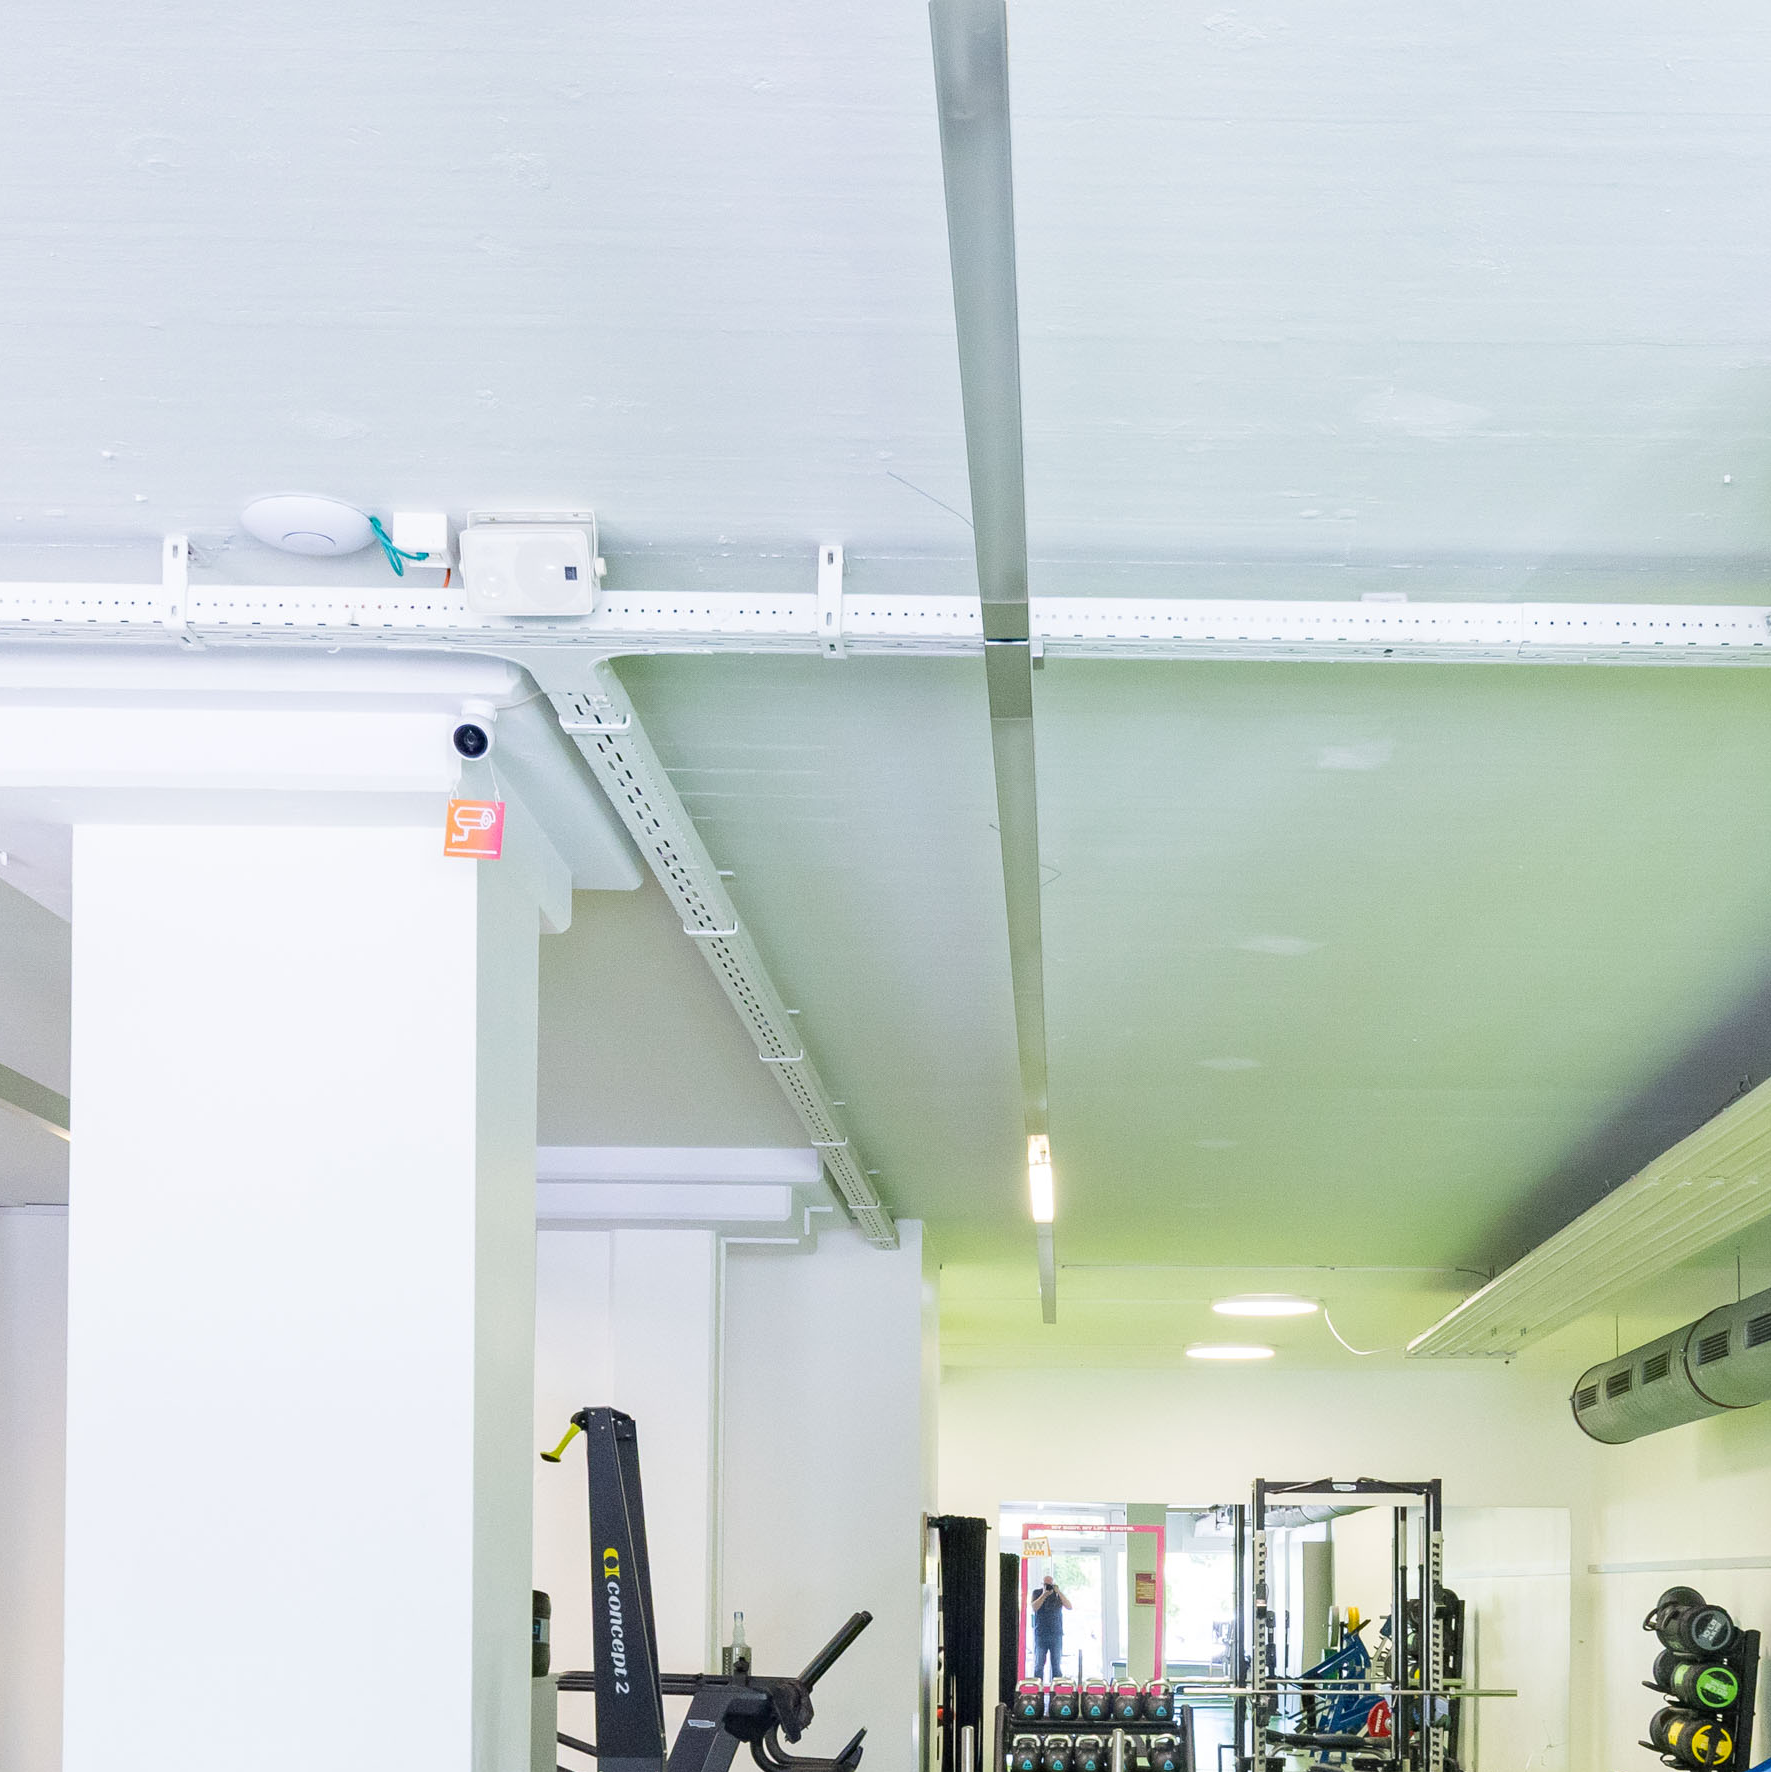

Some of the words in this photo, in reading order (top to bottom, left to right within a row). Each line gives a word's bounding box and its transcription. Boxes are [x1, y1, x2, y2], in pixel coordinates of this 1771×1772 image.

[1024, 1541, 1043, 1550] MY
[607, 1581, 628, 1677] concept
[615, 1682, 630, 1695] 2
